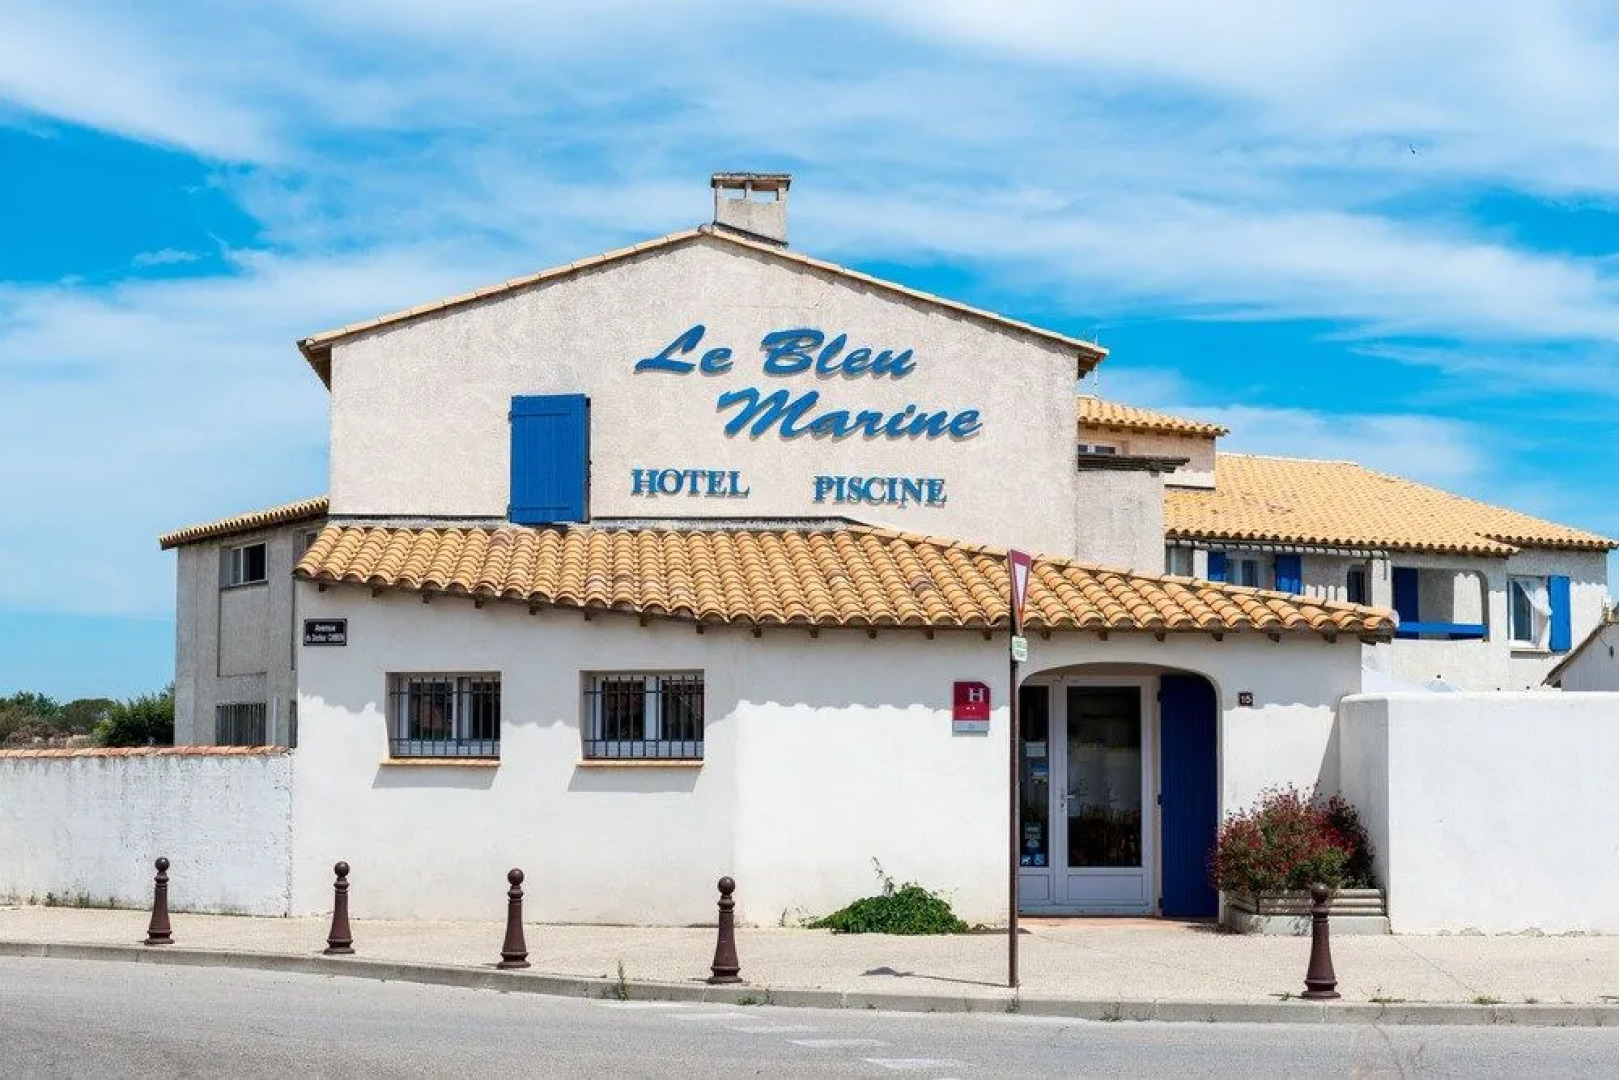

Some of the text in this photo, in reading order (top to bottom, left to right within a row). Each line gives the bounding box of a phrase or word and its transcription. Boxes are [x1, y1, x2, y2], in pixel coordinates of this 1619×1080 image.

[635, 325, 916, 377] Le Bleu
[716, 386, 981, 440] Marine
[631, 470, 947, 508] HOTEL PISCINE
[969, 687, 984, 702] H
